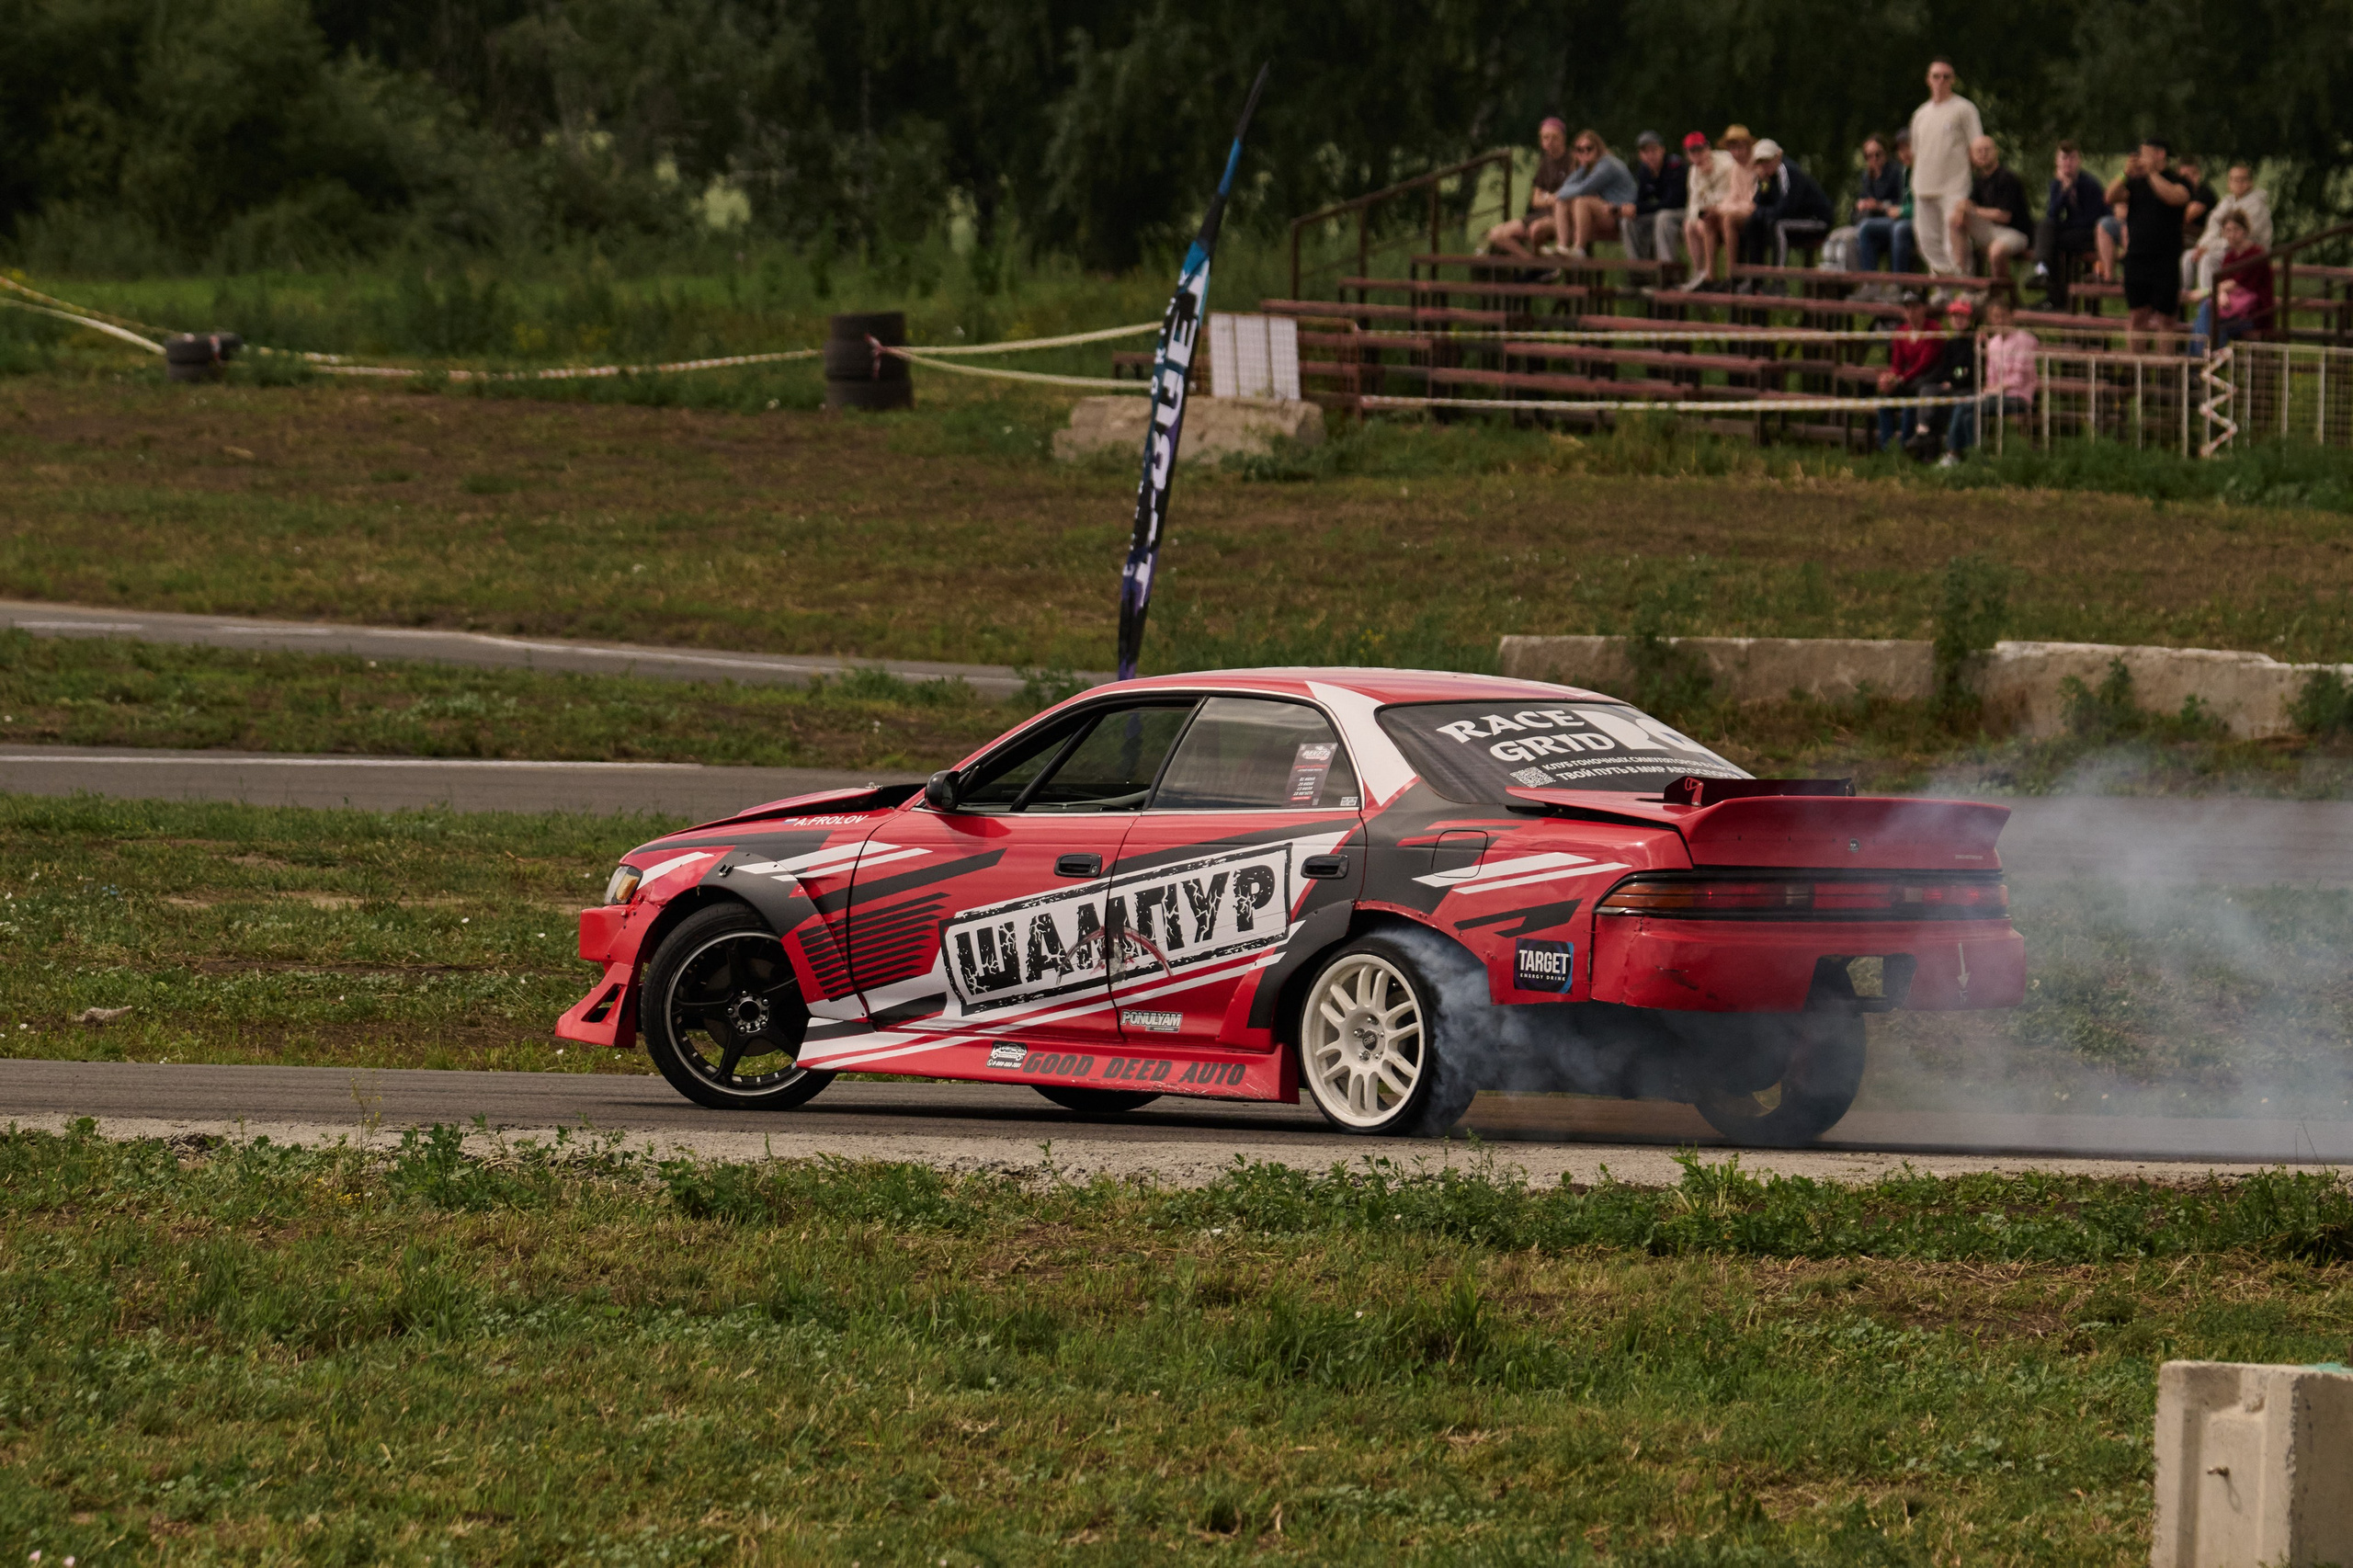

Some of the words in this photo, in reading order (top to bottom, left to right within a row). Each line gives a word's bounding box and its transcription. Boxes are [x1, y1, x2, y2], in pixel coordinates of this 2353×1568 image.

[1436, 710, 1585, 744] RACE
[1490, 733, 1616, 762] GRID
[1541, 760, 1573, 771] КЛУБ
[1571, 756, 1630, 767] ГОНОЧНЫХ
[1555, 767, 1597, 780] ТВОЙ
[1594, 767, 1630, 776] ПУТЬ
[793, 814, 870, 826] A.FROLOV
[956, 865, 1276, 995] ШАМПУР
[1518, 949, 1571, 974] TARGET
[1121, 1010, 1183, 1027] PONULYAM
